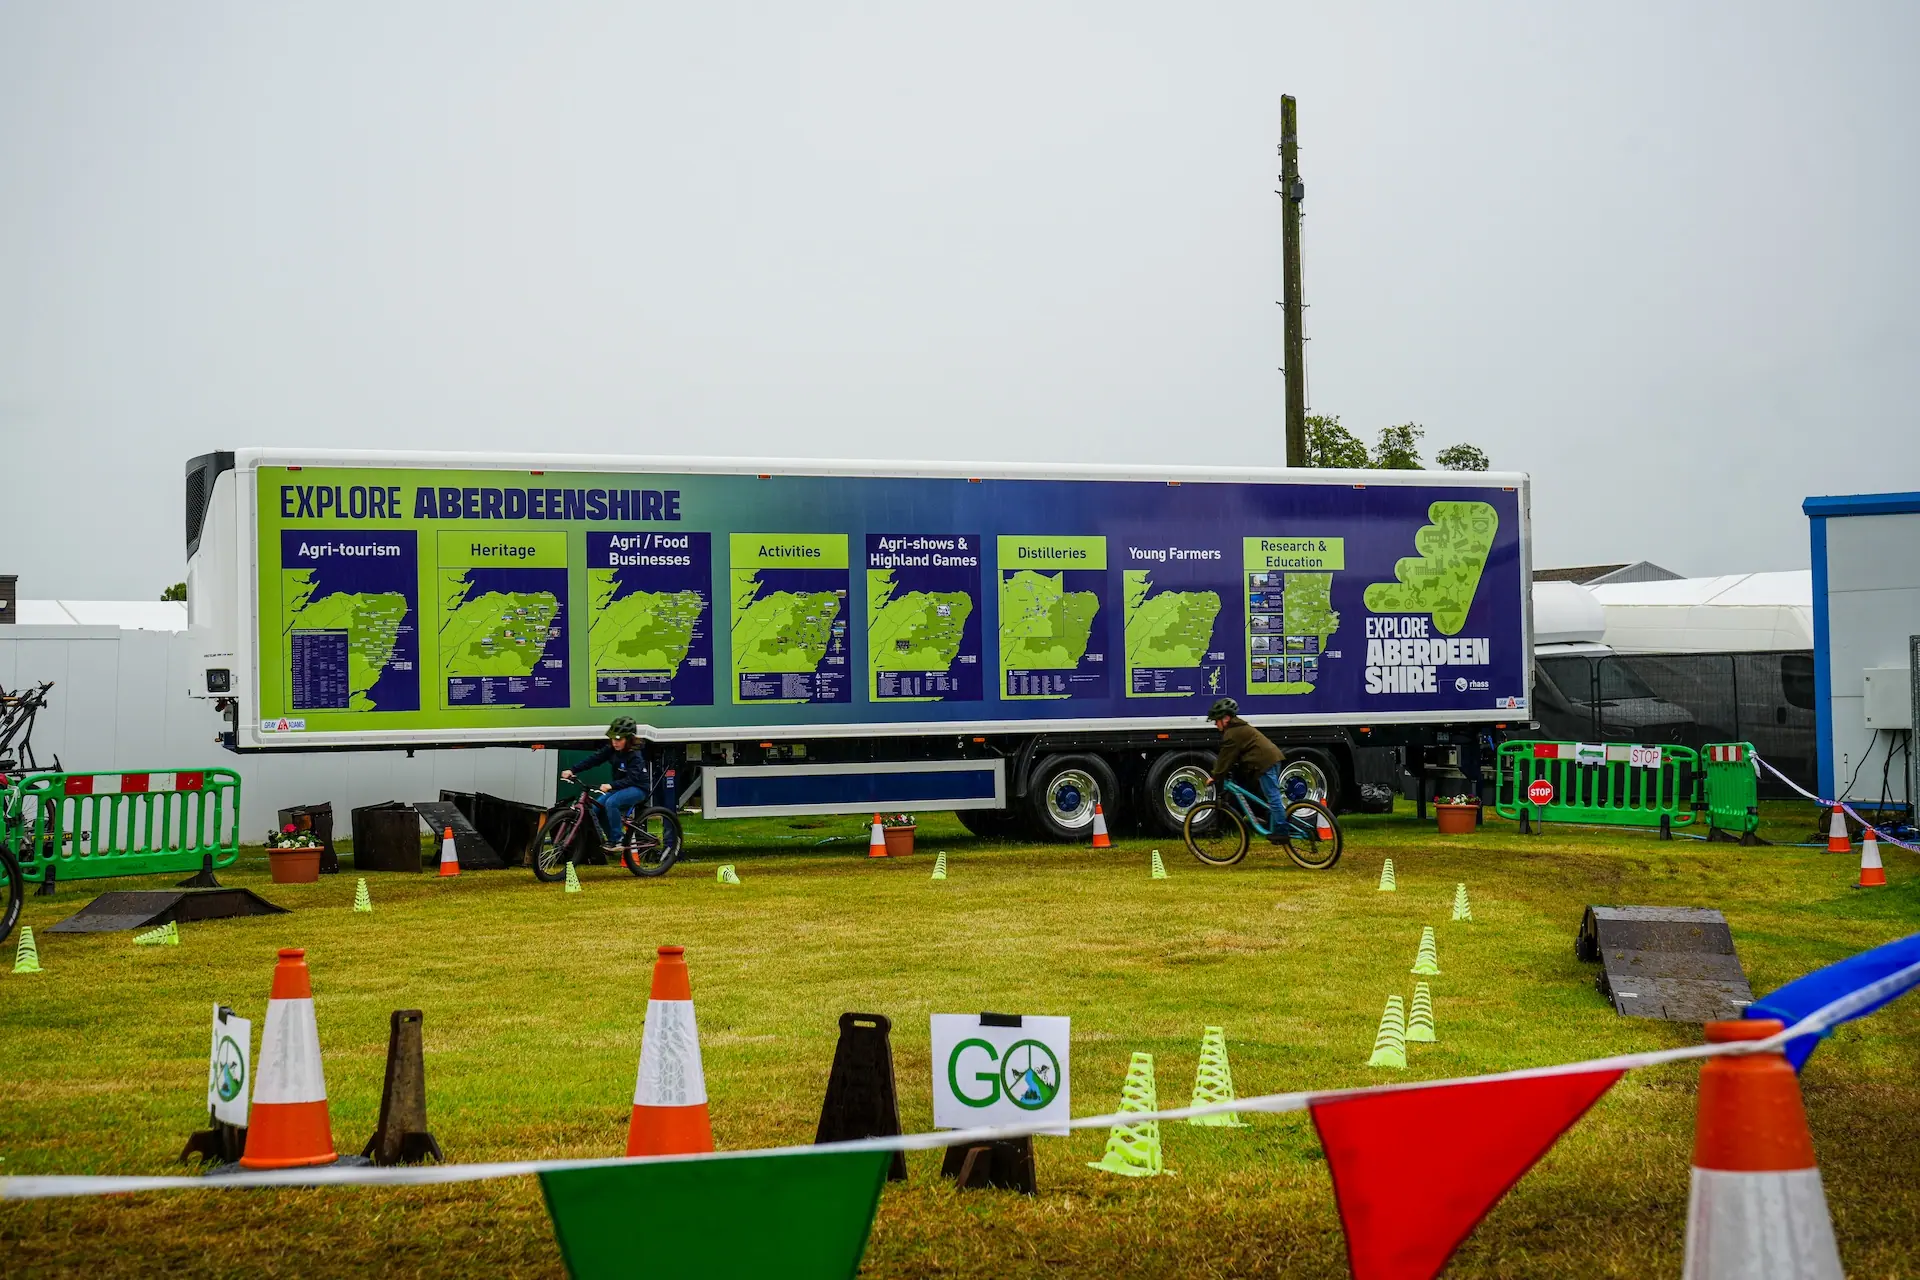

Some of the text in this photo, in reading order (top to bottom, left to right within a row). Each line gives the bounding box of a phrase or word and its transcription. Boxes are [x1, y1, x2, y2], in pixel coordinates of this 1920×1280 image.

[280, 486, 681, 522] EXPLORE ABERDEENSHIRE
[298, 541, 402, 560] Agri-tourism
[609, 534, 689, 551] Agri / Food
[878, 536, 969, 553] Agri-shows &
[1261, 540, 1328, 552] Research &
[470, 543, 536, 560] Heritage
[609, 551, 691, 567] Businesses
[758, 544, 821, 559] Activities
[1018, 545, 1087, 560] Distilleries
[1129, 547, 1222, 562] Young Farmers
[870, 552, 978, 569] Highland Games
[1265, 556, 1324, 568] Education
[1365, 616, 1429, 638] EXPLORE
[1366, 638, 1490, 666] ABERDEEN
[1365, 666, 1437, 695] SHIRE
[1469, 679, 1490, 688] rhass
[1632, 749, 1660, 764] STOP
[1530, 787, 1551, 797] STOP
[947, 1037, 1062, 1111] GO
